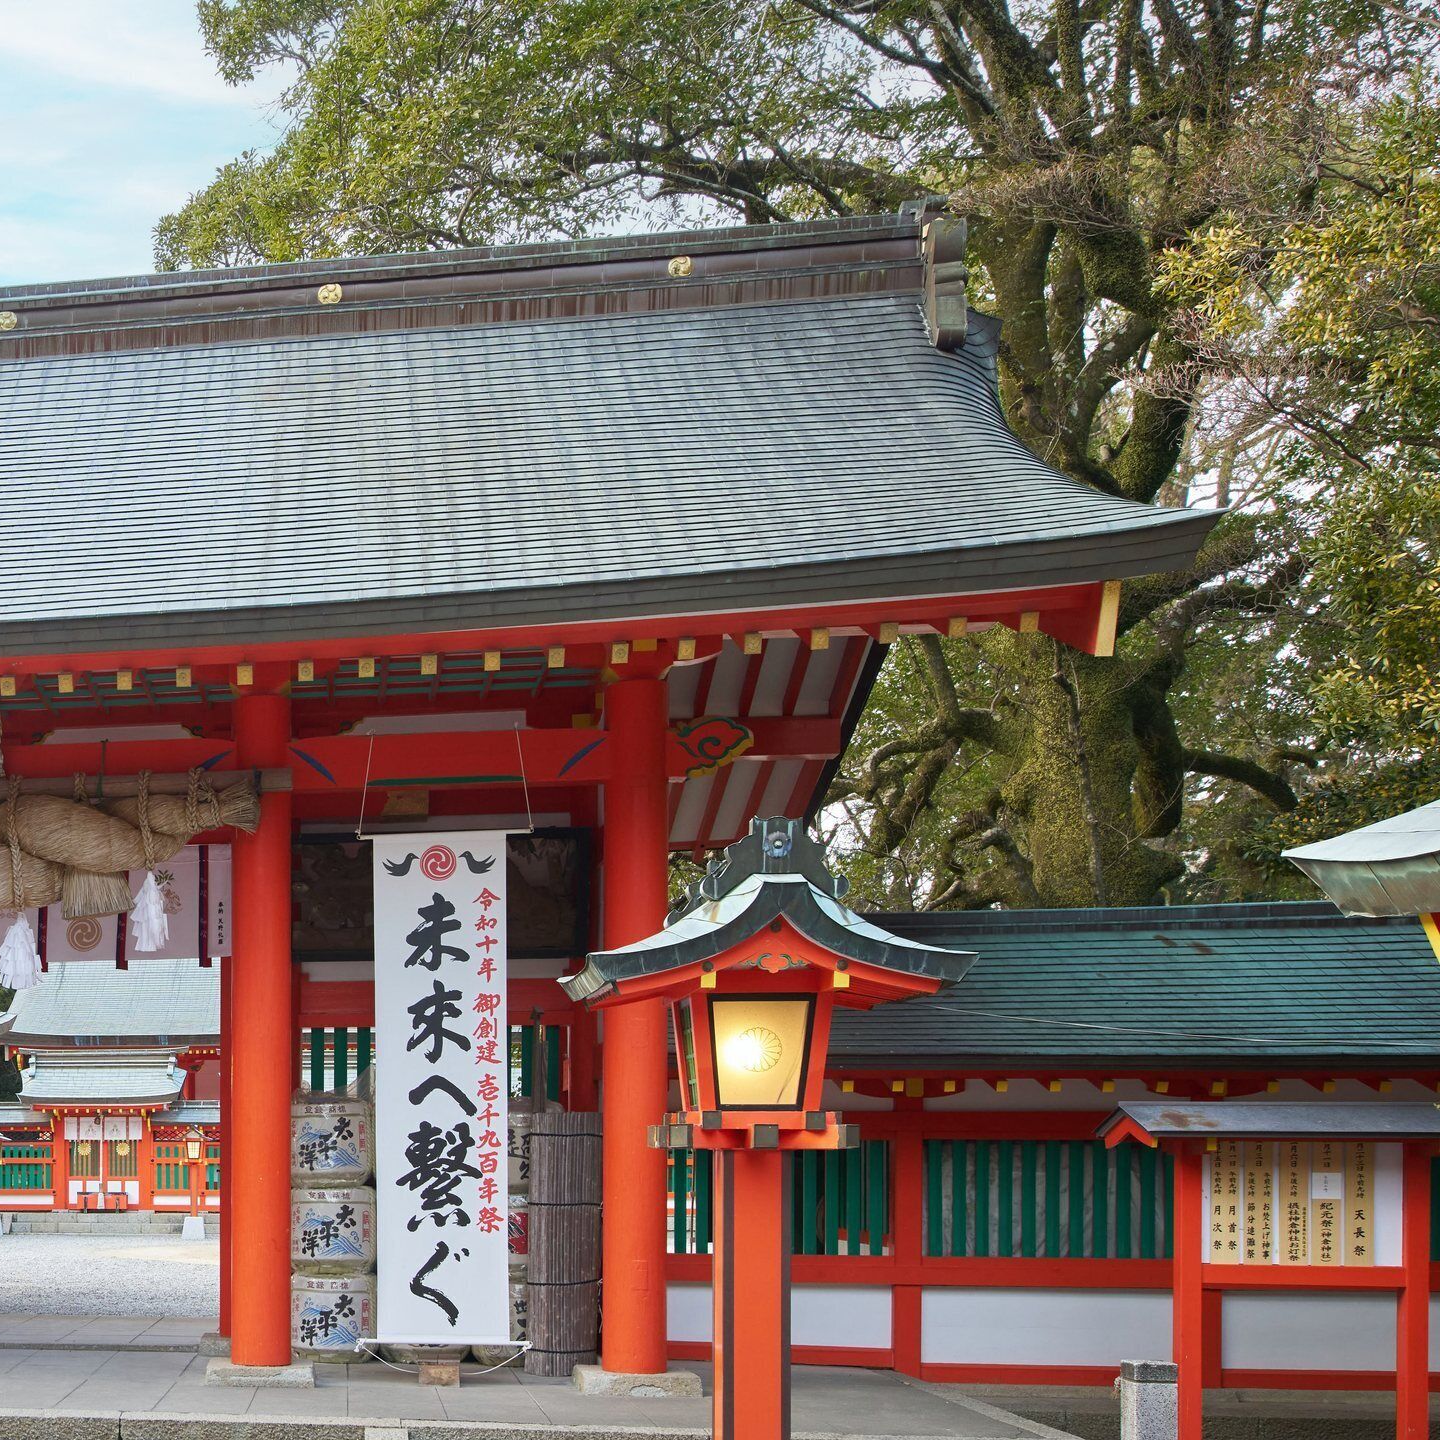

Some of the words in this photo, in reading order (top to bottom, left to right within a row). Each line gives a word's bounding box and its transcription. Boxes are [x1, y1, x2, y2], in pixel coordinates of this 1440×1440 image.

[472, 887, 500, 983] 令和十年
[472, 992, 500, 1065] 御創建
[396, 892, 482, 1328] 未来へ繋ぐ
[475, 1073, 504, 1234] 壱千九百年祭
[301, 1204, 356, 1258] 太平洋
[1212, 1205, 1222, 1251] 月次祭
[1227, 1205, 1237, 1251] 月首祭
[1354, 1209, 1366, 1256] 天長祭
[300, 1294, 356, 1347] 太平洋
